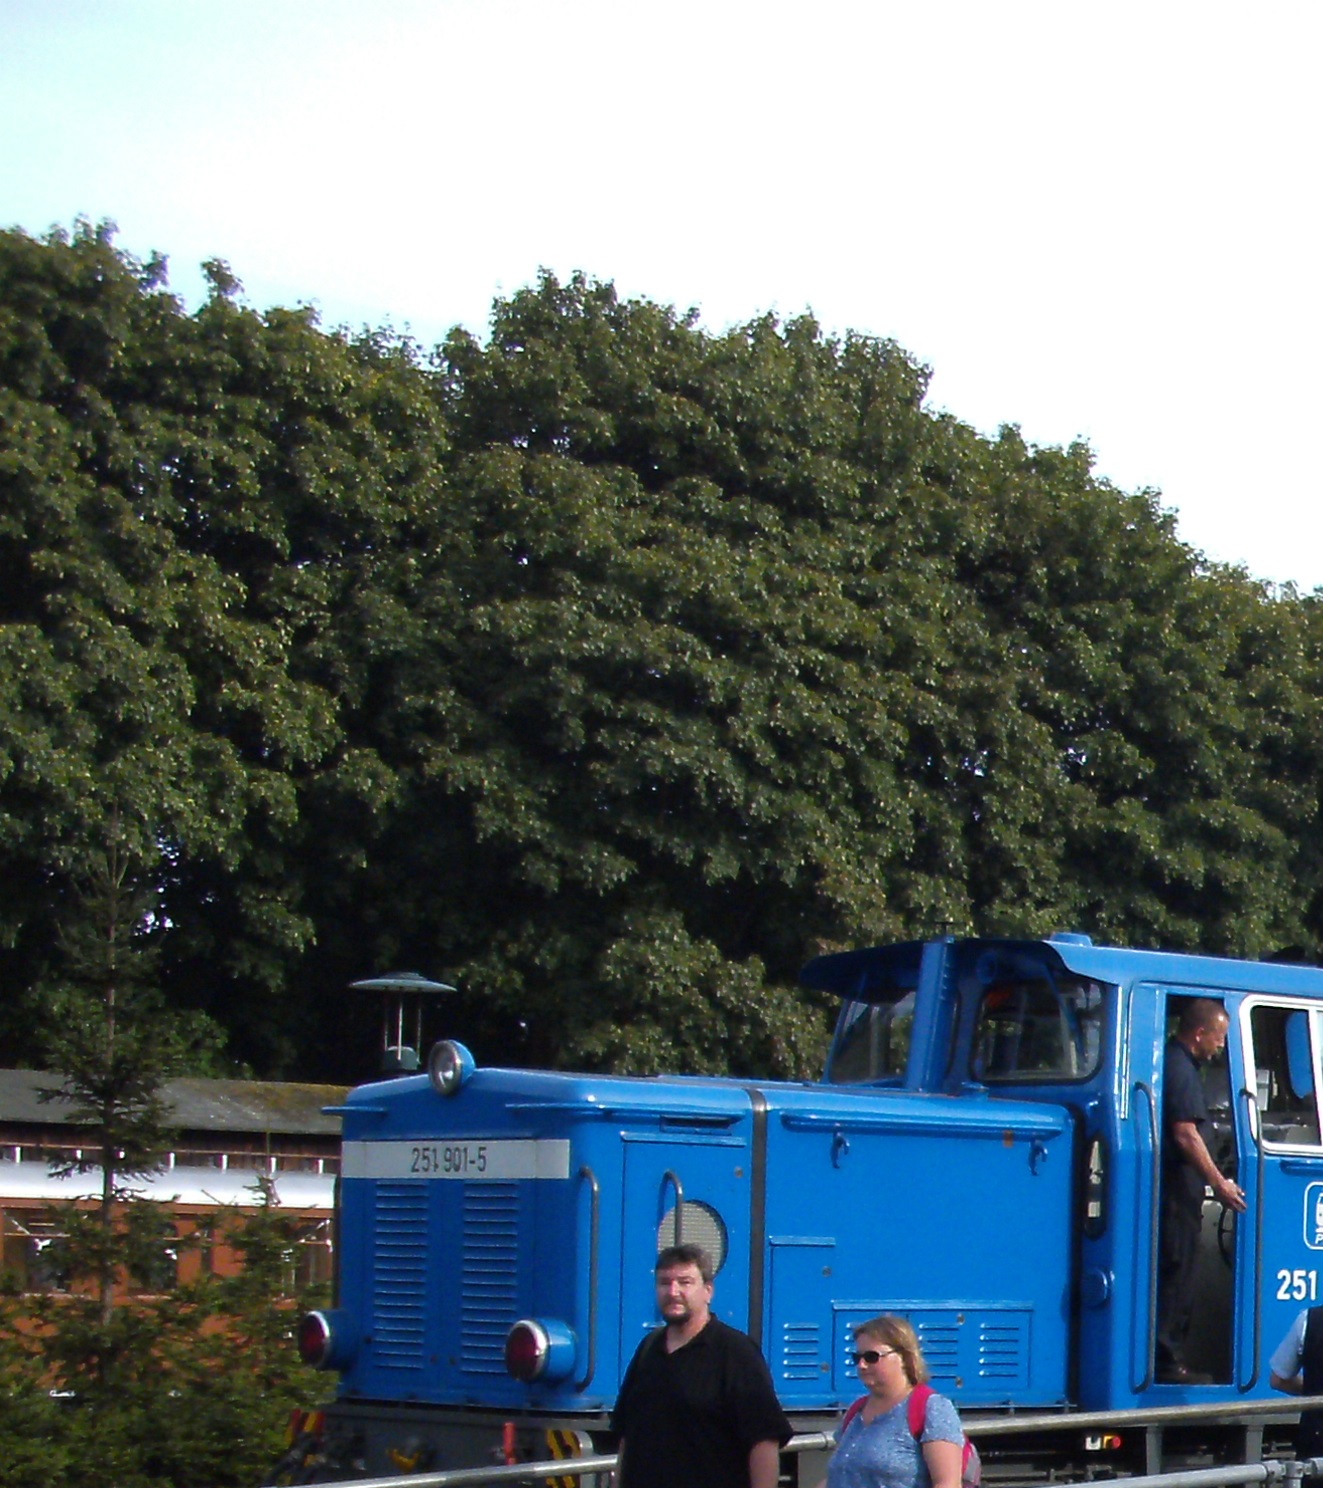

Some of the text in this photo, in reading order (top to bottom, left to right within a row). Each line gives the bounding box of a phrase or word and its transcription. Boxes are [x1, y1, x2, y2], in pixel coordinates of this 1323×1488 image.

[411, 1146, 488, 1173] 251 901-5
[1277, 1269, 1317, 1301] 251
